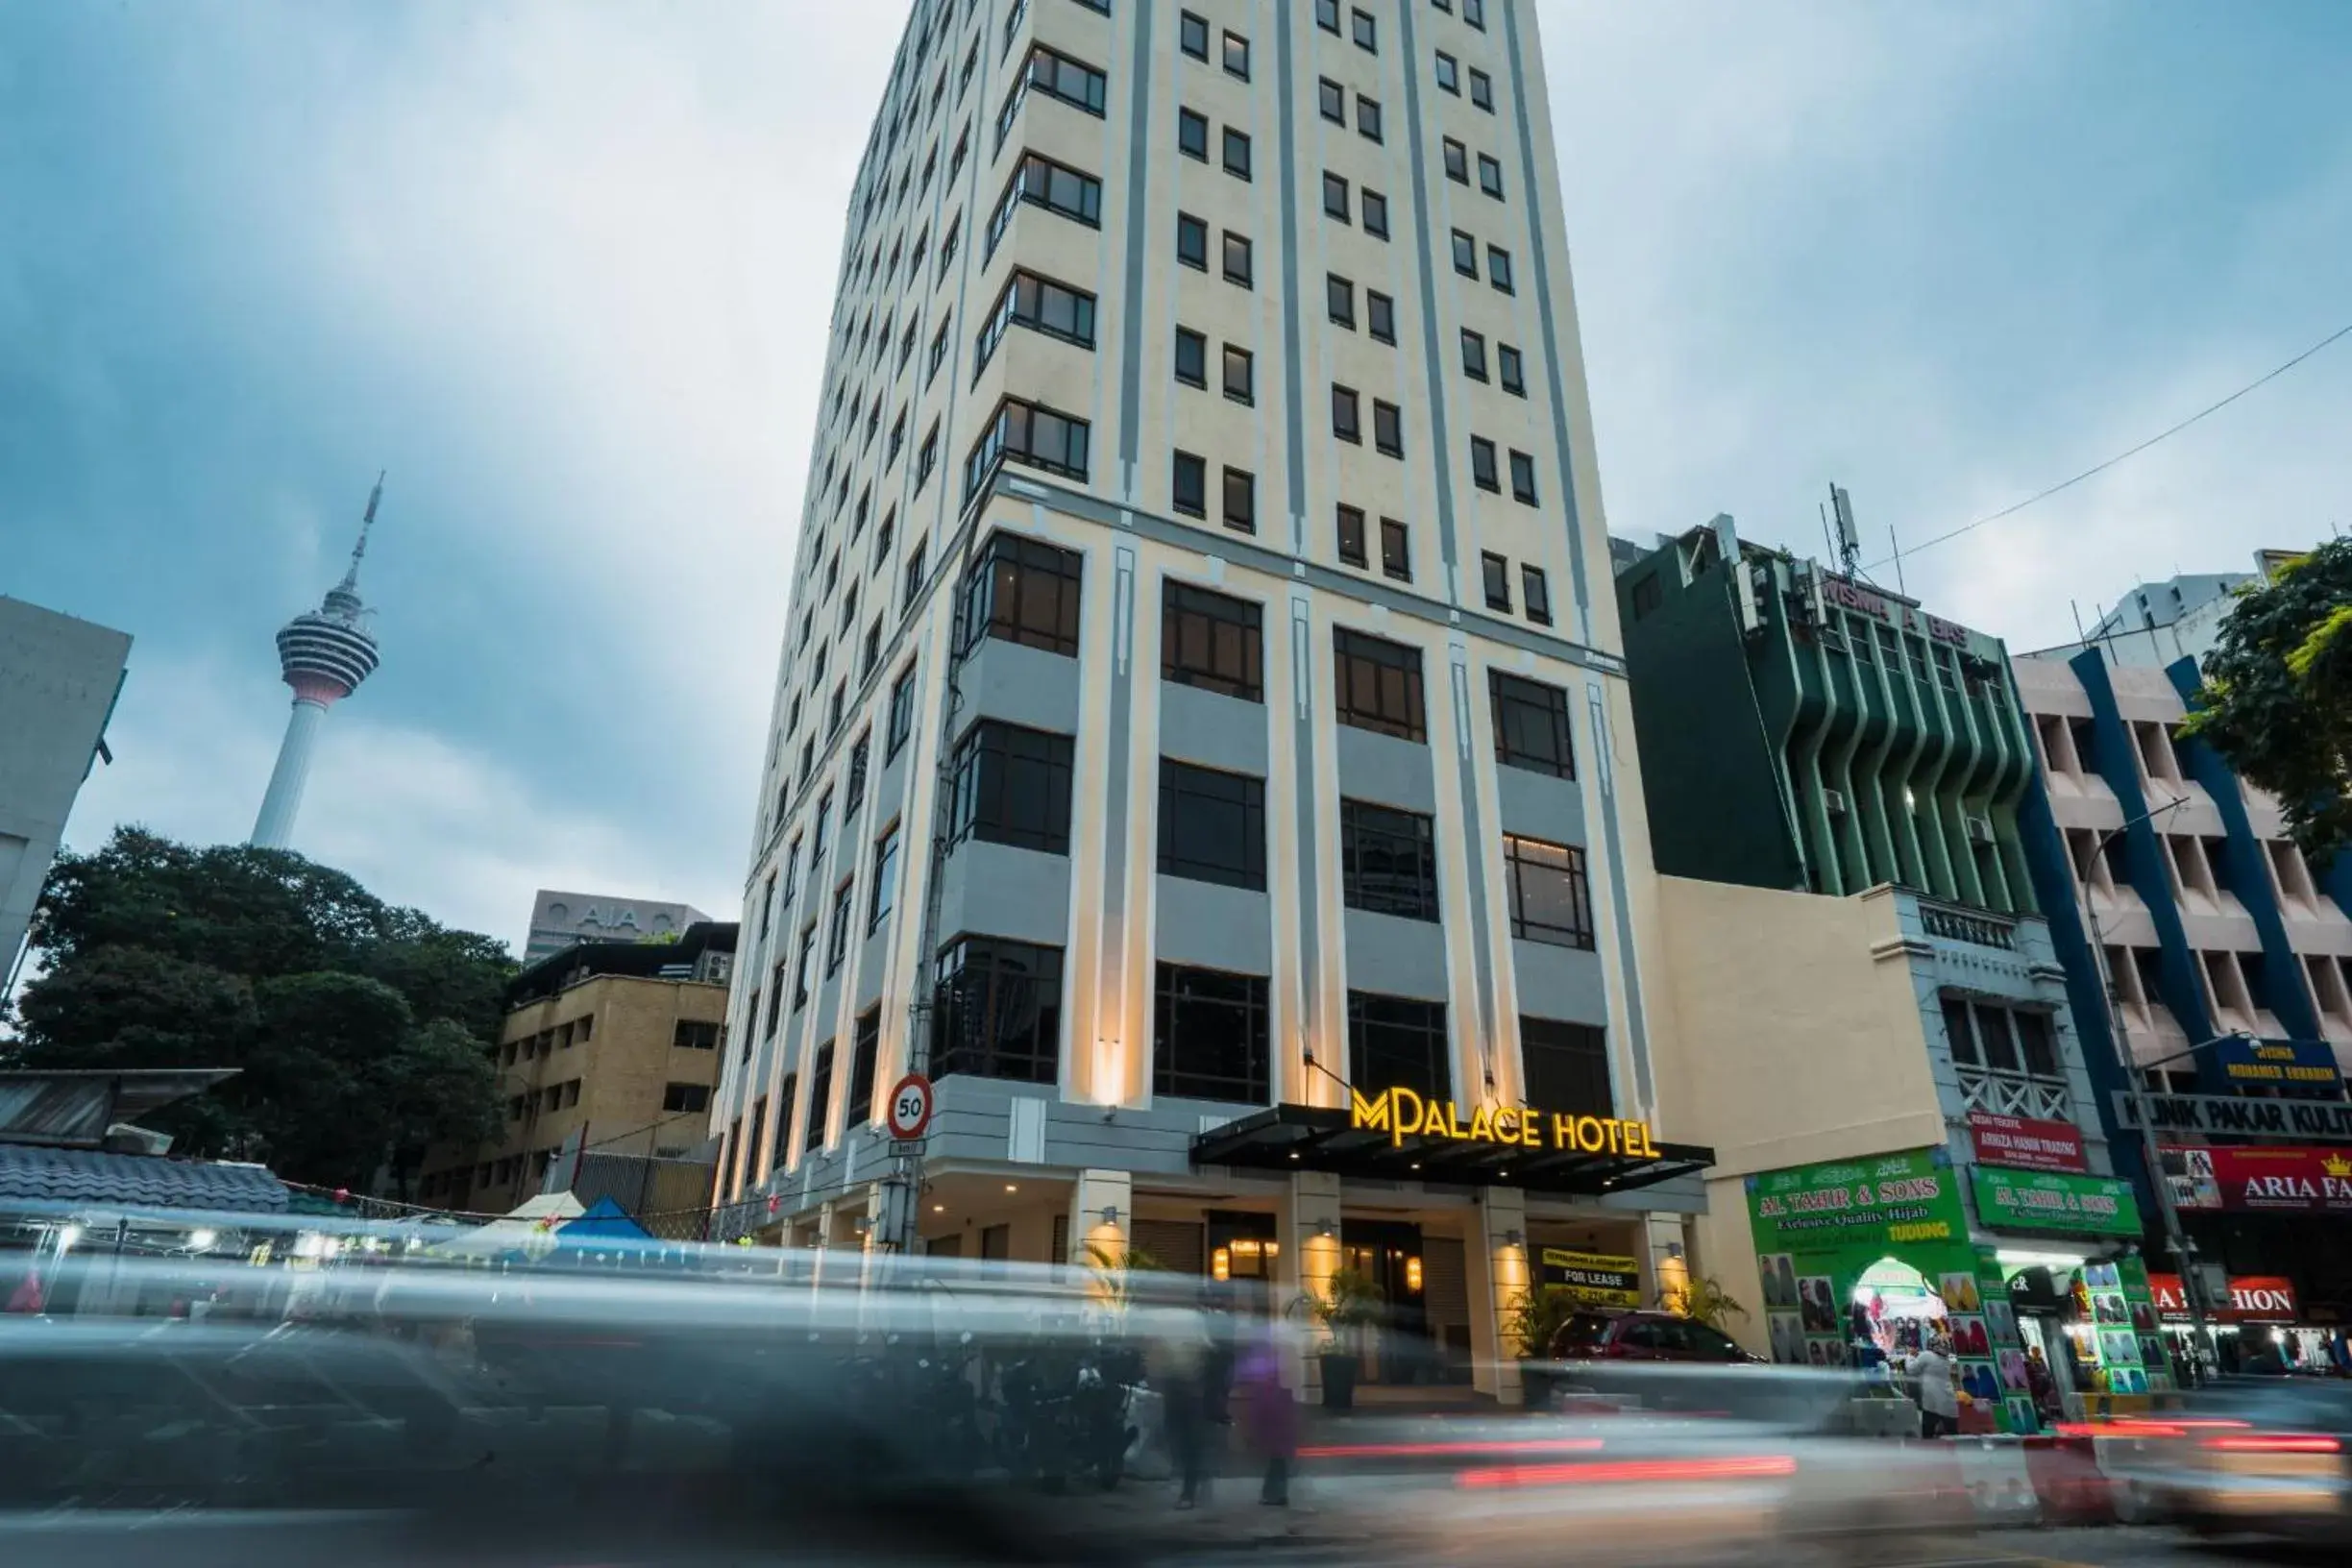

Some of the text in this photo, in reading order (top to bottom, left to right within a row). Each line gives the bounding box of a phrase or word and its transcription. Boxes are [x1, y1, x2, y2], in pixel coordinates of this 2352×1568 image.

[578, 904, 642, 933] AIA
[898, 1097, 921, 1116] 50
[2205, 1100, 2287, 1132] PAKAR
[1554, 1113, 1661, 1158] HOTEL
[1759, 1196, 1787, 1216] AL
[1856, 1185, 1874, 1206] &
[1878, 1176, 1940, 1203] SONS
[2244, 1176, 2319, 1197] ARIA
[1835, 1212, 1883, 1227] Quality
[1888, 1205, 1928, 1220] Hijab
[1887, 1222, 1950, 1242] TUDUNG
[1564, 1269, 1623, 1286] FOR LEASE
